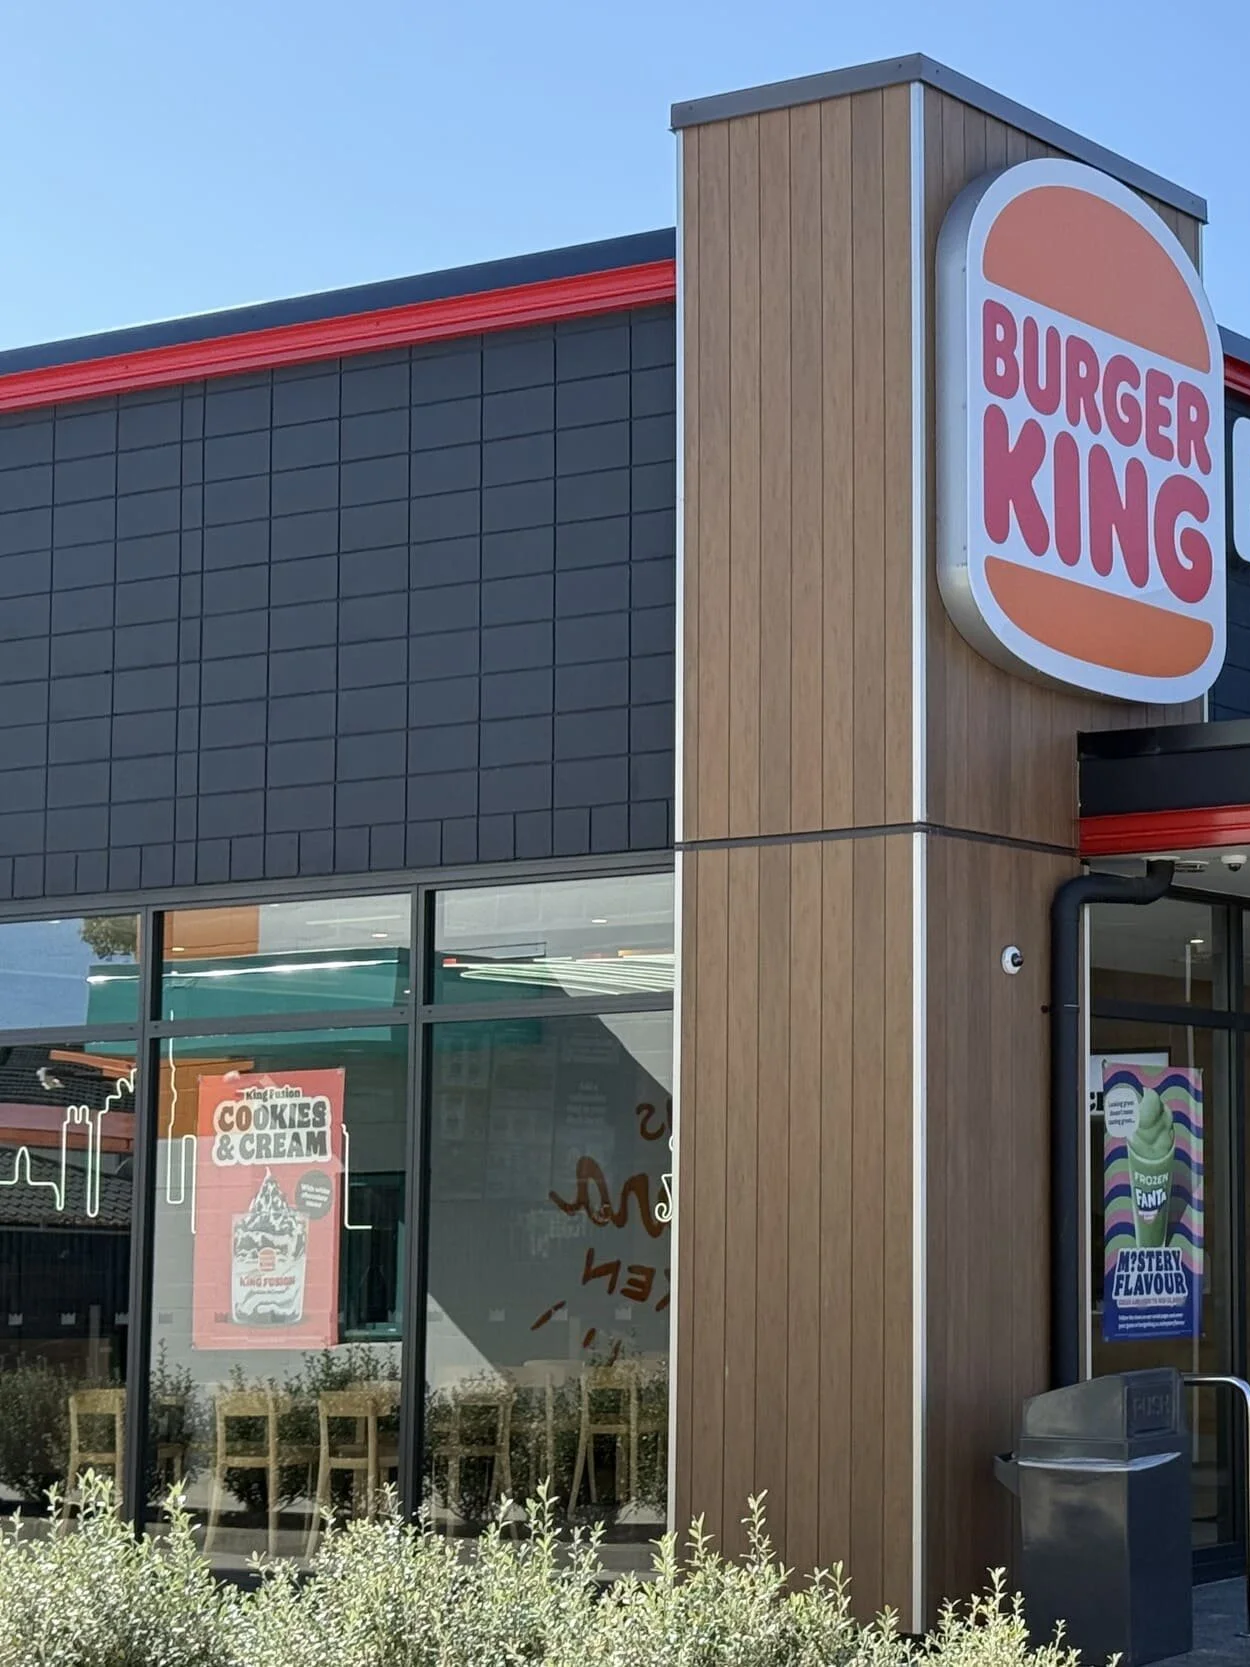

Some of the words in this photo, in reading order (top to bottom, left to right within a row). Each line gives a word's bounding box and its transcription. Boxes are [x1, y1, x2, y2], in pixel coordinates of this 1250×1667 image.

[982, 298, 1212, 475] BURGER
[983, 403, 1213, 604] KING
[246, 1089, 268, 1102] King
[269, 1087, 301, 1099] Fusion
[218, 1101, 327, 1132] COOKIES
[216, 1134, 235, 1161] &
[239, 1131, 328, 1160] CREAM
[1134, 1171, 1169, 1186] FROZEN
[1135, 1187, 1167, 1209] FANTA
[1117, 1250, 1181, 1272] M?STERY
[1114, 1272, 1187, 1297] FLAVOUR
